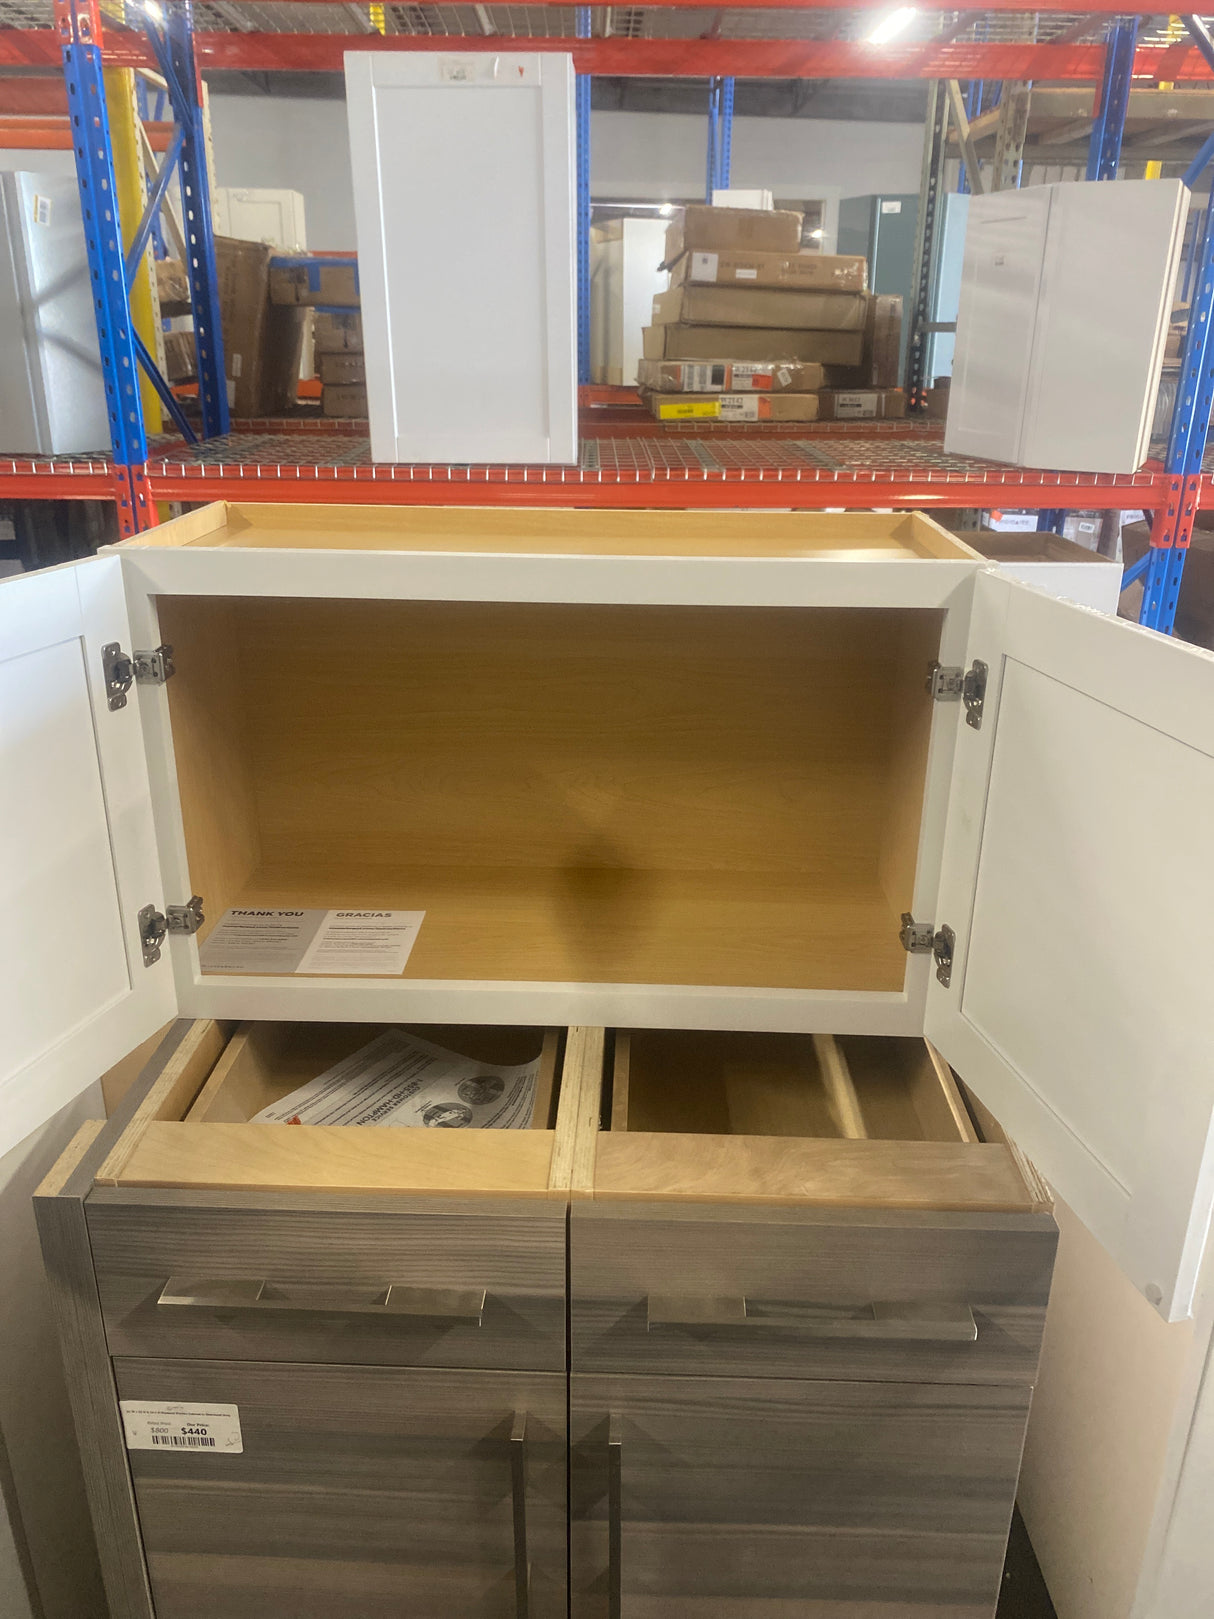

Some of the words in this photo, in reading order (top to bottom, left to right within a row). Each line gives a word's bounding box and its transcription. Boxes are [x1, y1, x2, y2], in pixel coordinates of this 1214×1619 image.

[391, 1086, 421, 1107] CUSTOMER
[370, 1105, 394, 1123] SERVICE
[181, 1427, 207, 1436] $440
